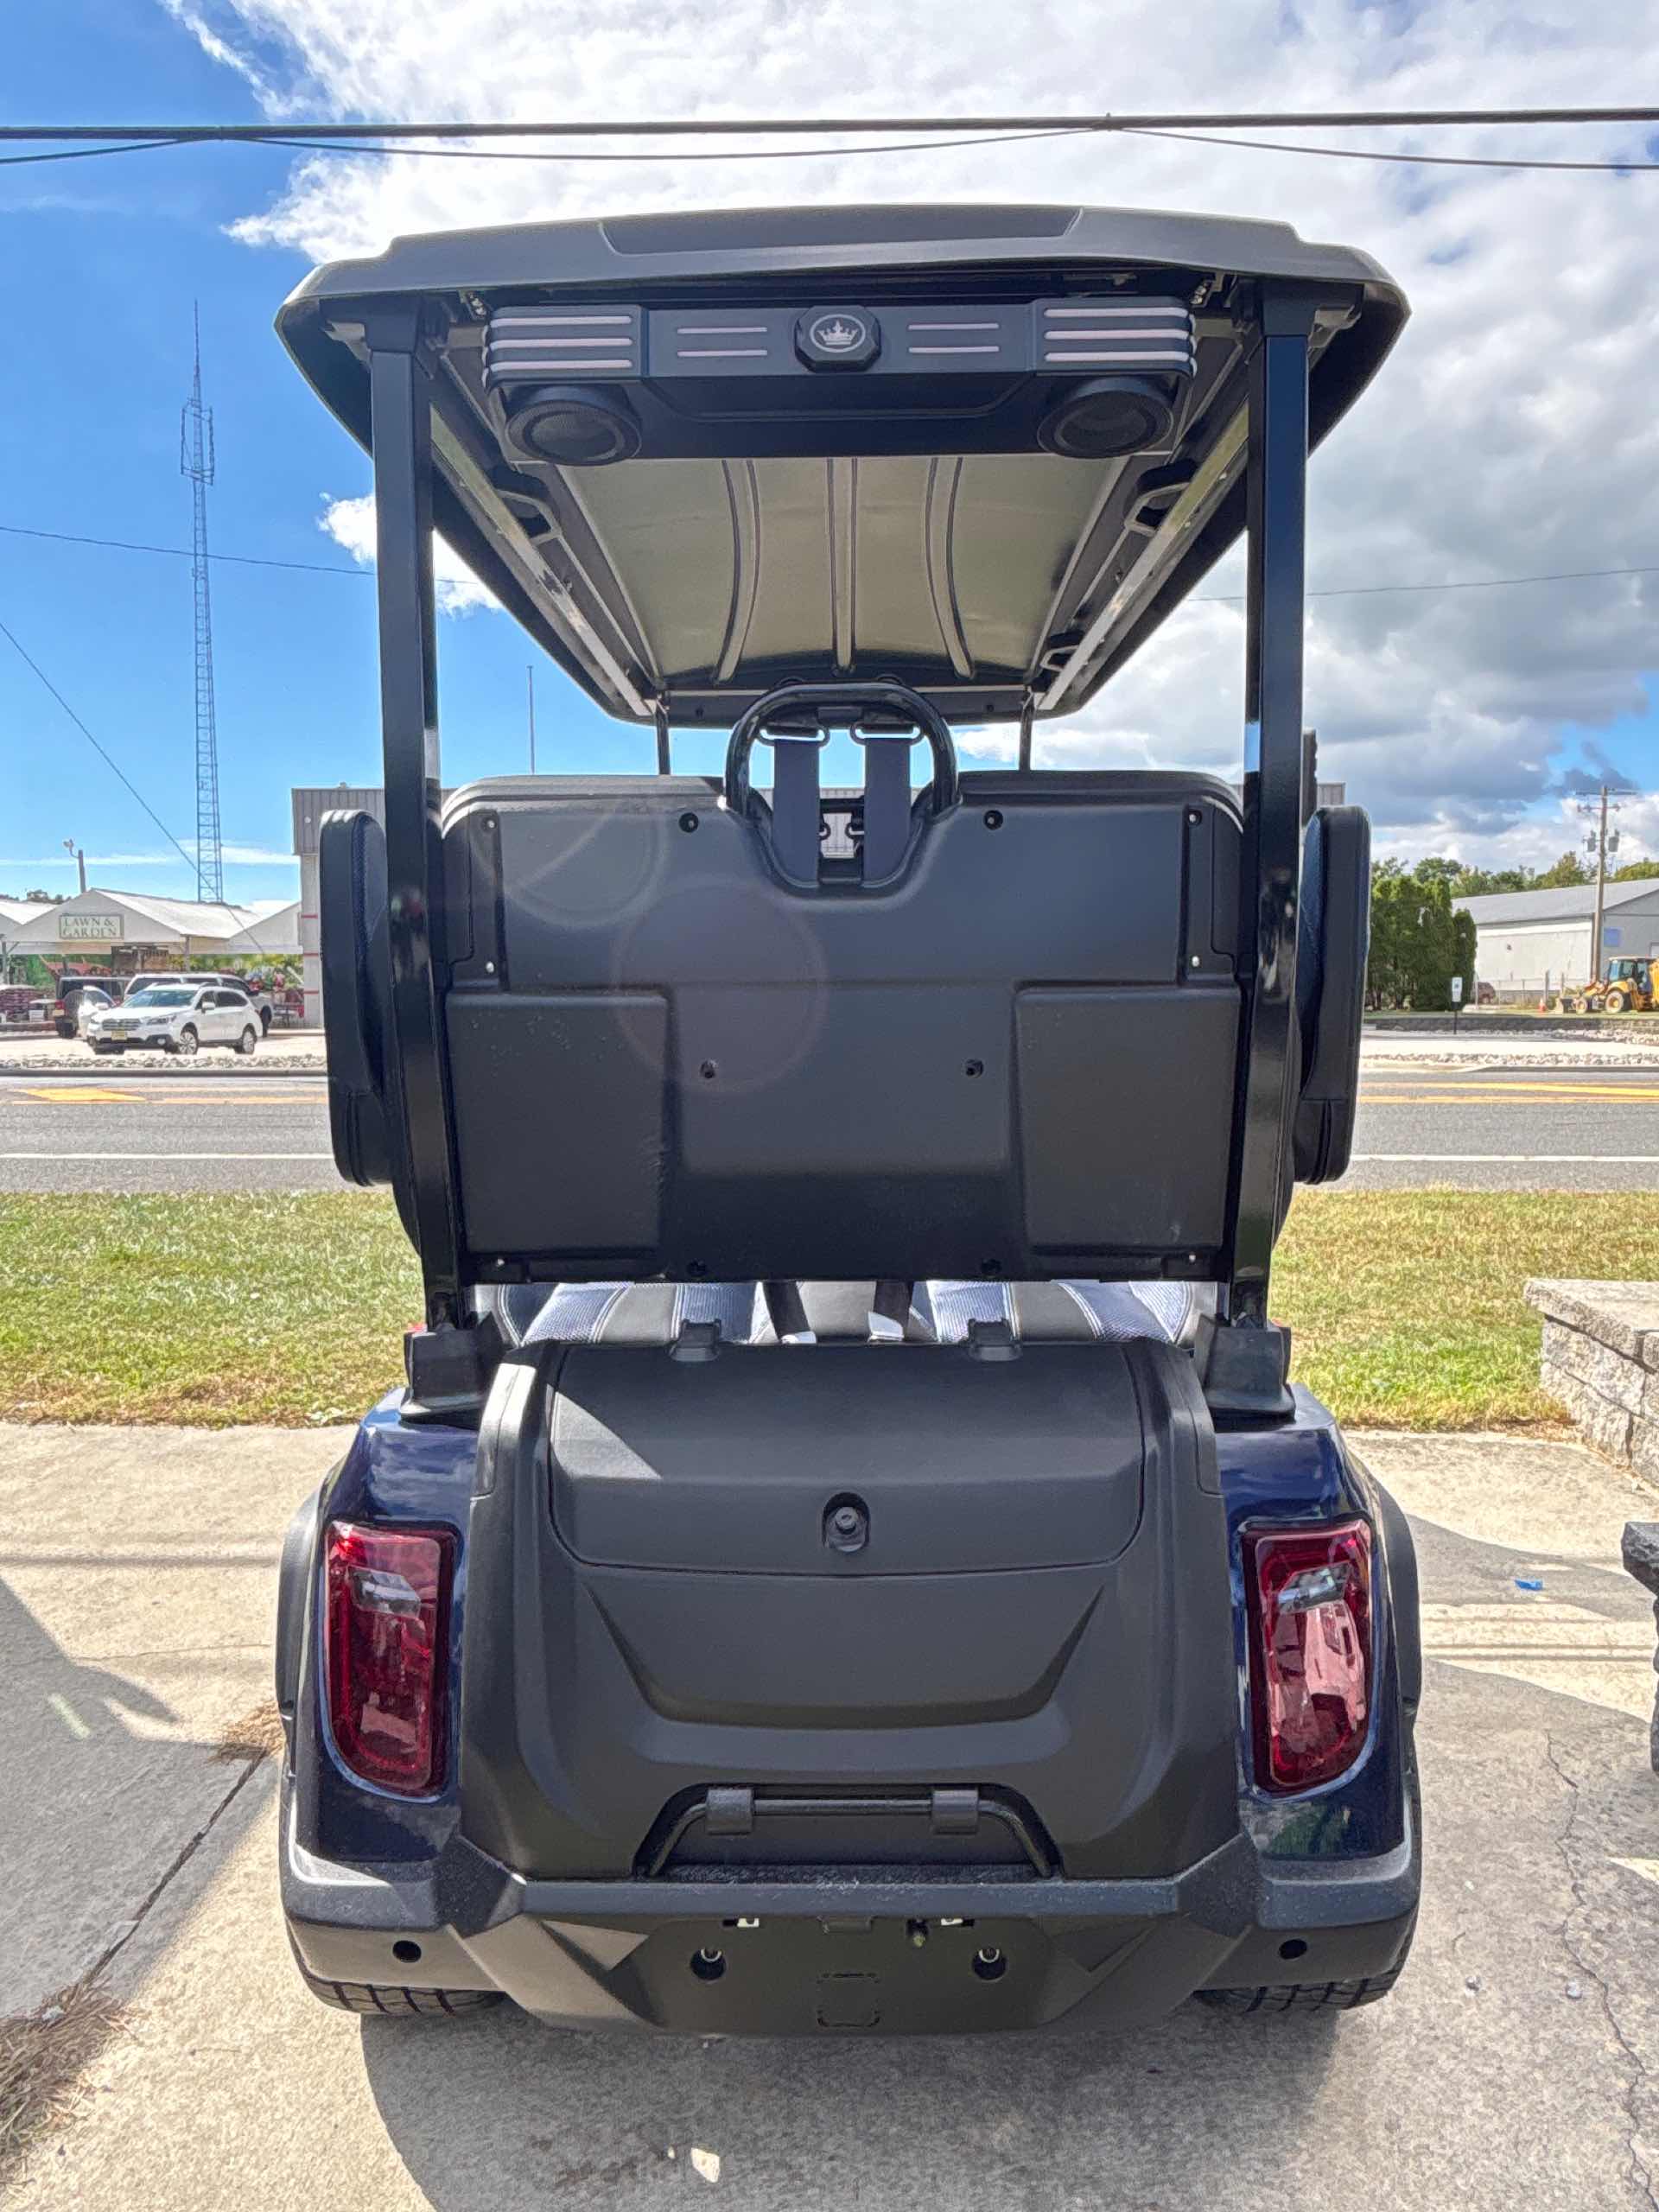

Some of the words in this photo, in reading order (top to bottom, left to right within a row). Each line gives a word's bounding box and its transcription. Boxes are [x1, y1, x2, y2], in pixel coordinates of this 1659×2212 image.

[64, 918, 100, 927] LAWN
[104, 918, 115, 927] &
[62, 927, 117, 938] GARDEN
